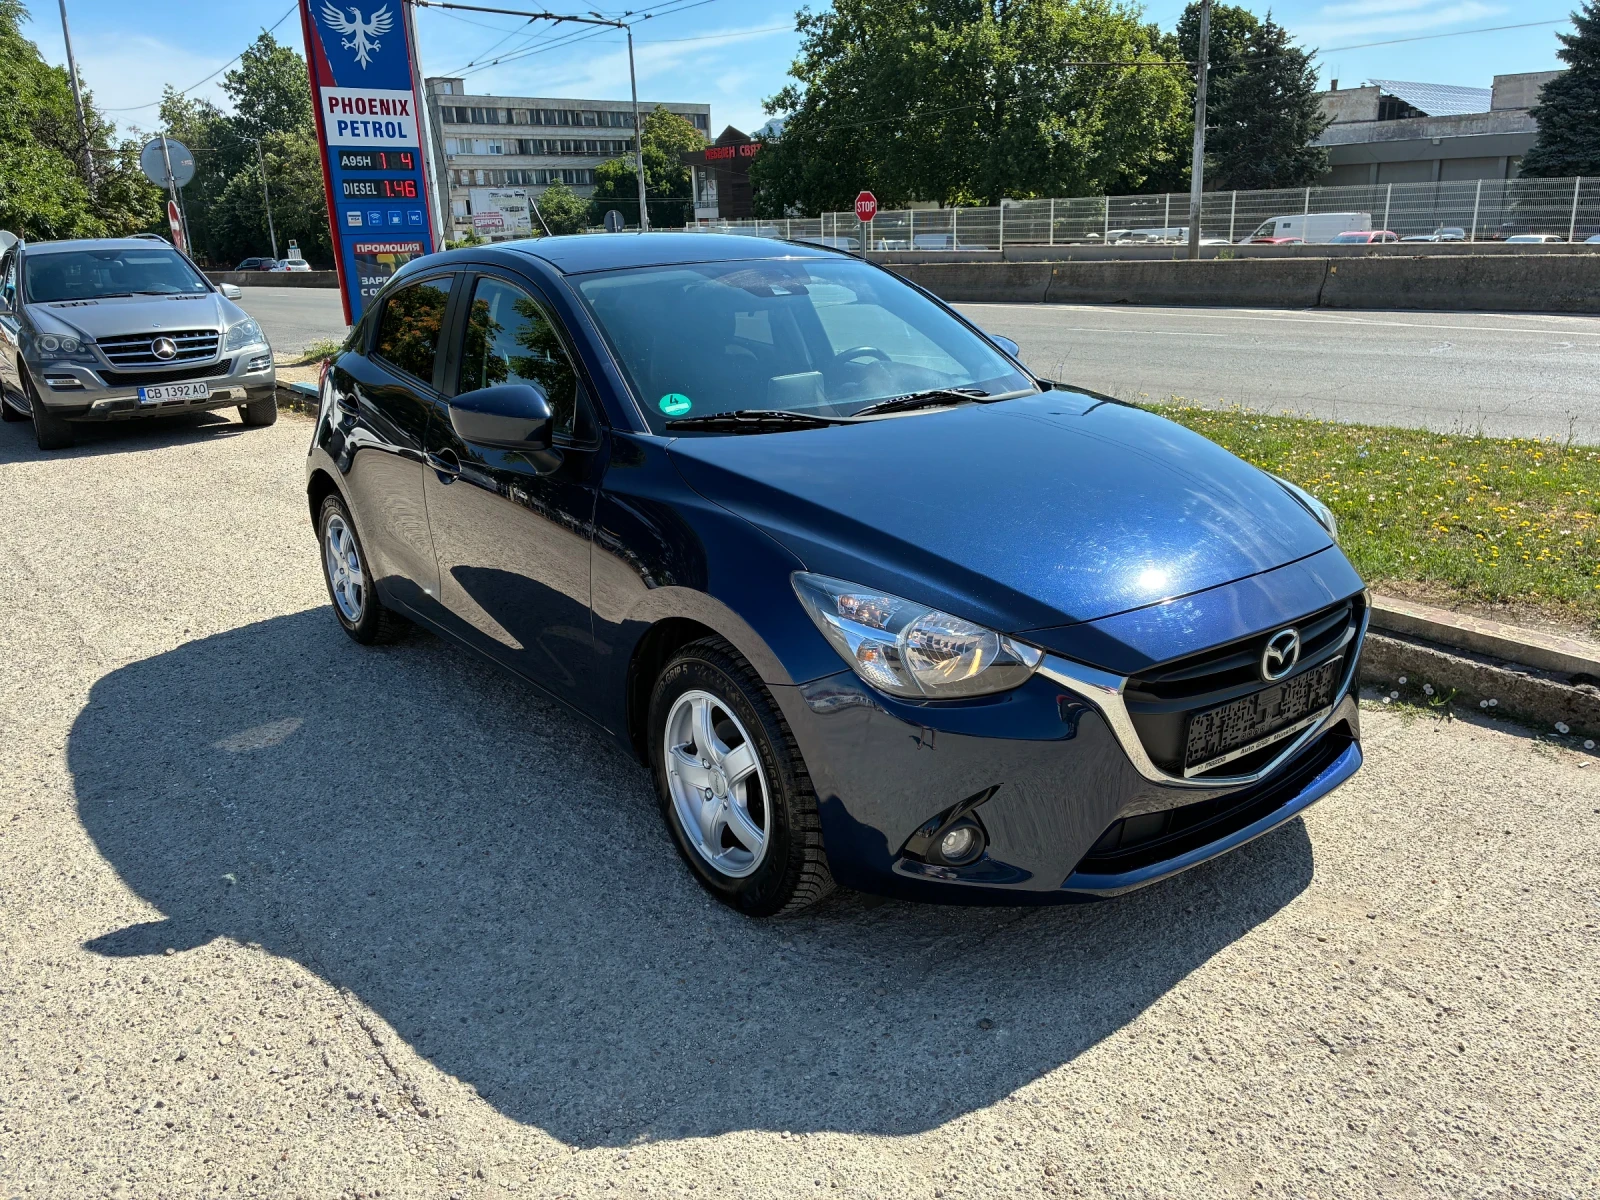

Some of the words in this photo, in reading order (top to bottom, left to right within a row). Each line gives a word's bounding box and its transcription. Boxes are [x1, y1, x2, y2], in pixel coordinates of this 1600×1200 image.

[328, 96, 410, 116] PHOENIX
[337, 120, 407, 138] PETROL
[343, 182, 378, 195] DIESEL
[384, 180, 416, 197] 1.46
[857, 201, 875, 212] STOP
[356, 243, 420, 253] ПРОМОЦИЯ
[147, 388, 162, 399] CB
[165, 385, 190, 397] 1392
[669, 394, 679, 405] 4
[1240, 745, 1255, 755] Auto
